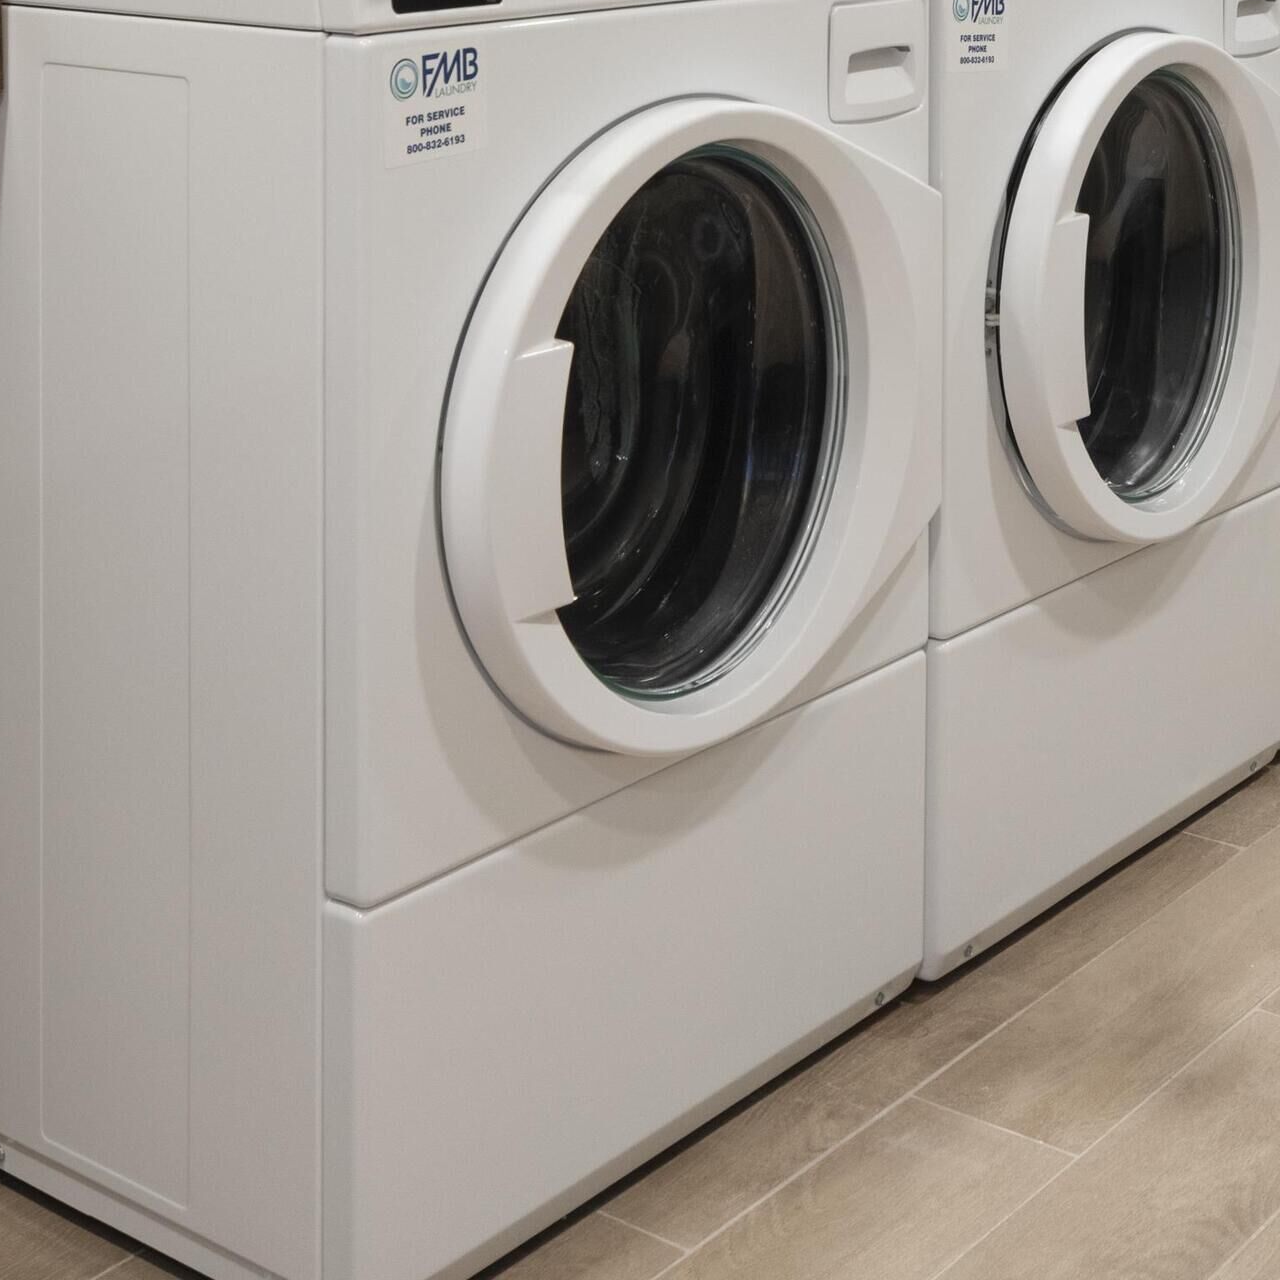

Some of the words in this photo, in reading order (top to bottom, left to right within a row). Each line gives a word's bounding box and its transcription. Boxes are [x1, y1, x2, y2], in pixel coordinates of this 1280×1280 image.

[978, 17, 1004, 25] LAUNDRY
[973, 34, 996, 42] SERVICE
[968, 45, 987, 53] PHONE
[421, 47, 479, 98] FMB
[434, 80, 478, 99] LAUNDRY
[406, 114, 424, 126] FOR
[427, 106, 465, 122] SERVICE
[420, 123, 452, 138] PHONE
[406, 134, 466, 154] 800-832-6193
